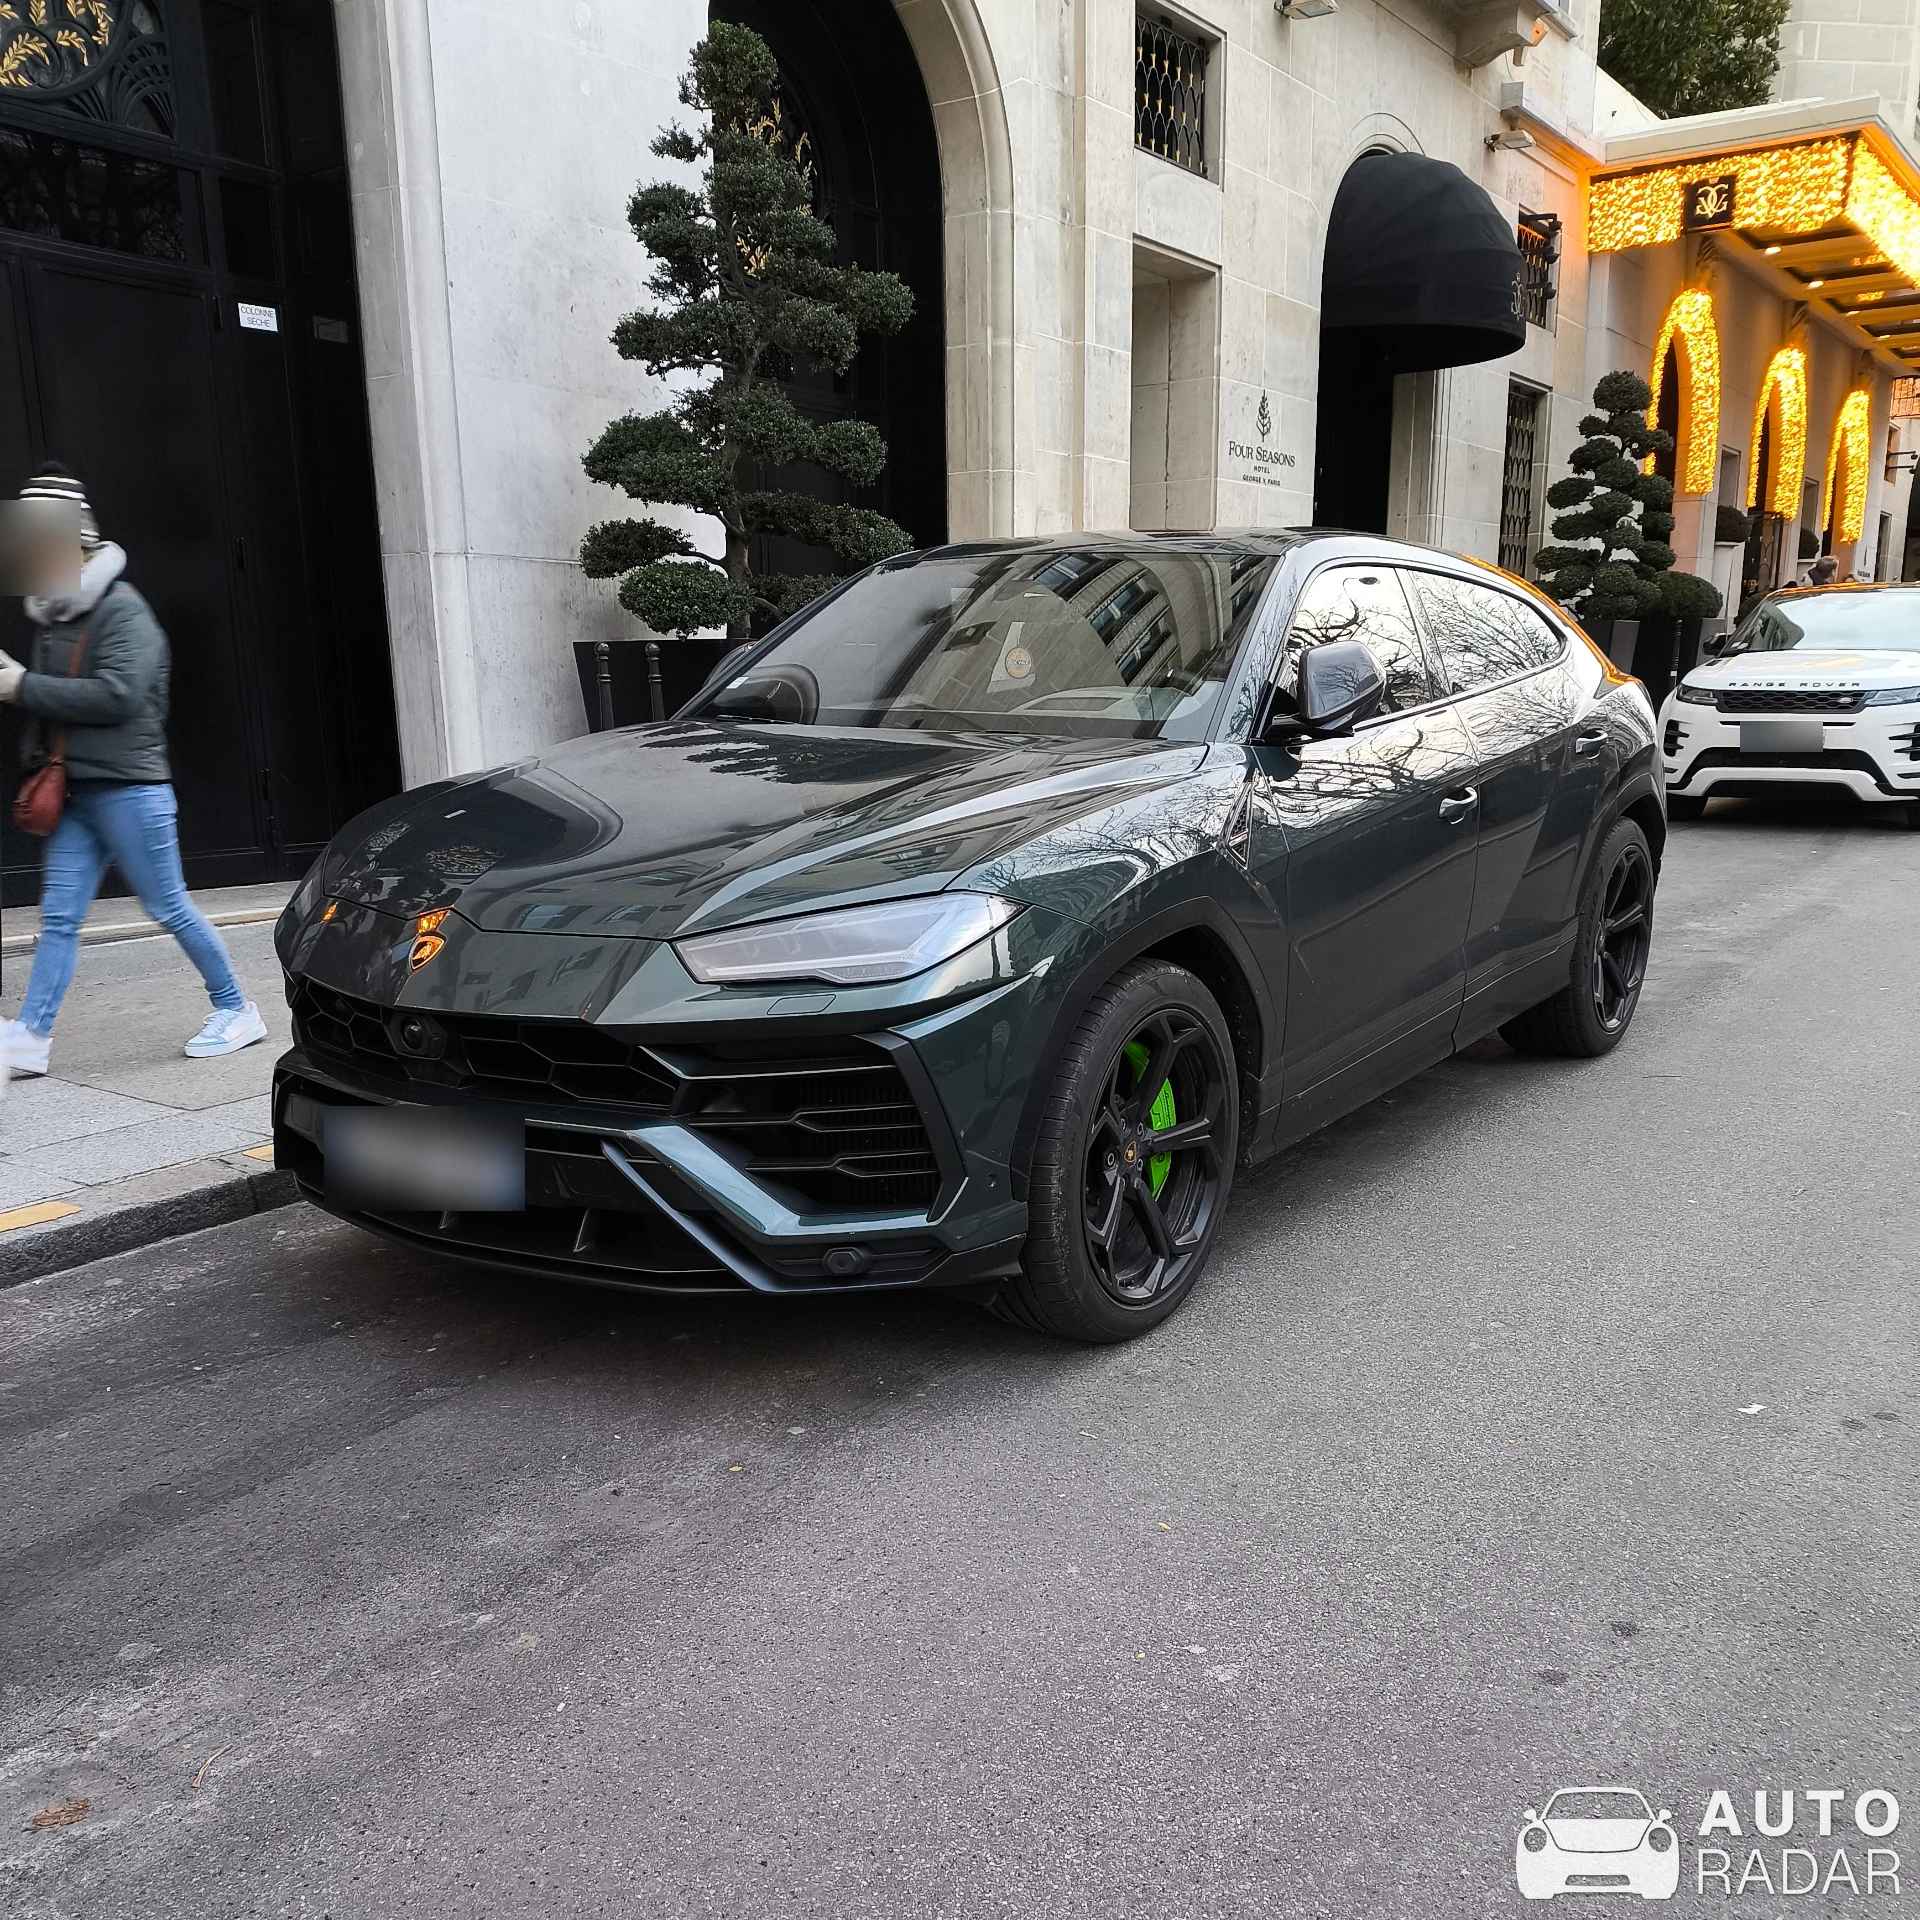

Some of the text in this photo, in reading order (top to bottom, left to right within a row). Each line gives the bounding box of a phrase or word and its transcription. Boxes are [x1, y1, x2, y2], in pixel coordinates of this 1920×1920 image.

[241, 306, 274, 318] COLONNE
[1228, 440, 1296, 468] FOUR SEASONS
[1253, 465, 1271, 474] HOTEL
[1242, 474, 1262, 484] GEORGE
[1267, 478, 1281, 487] PARIS
